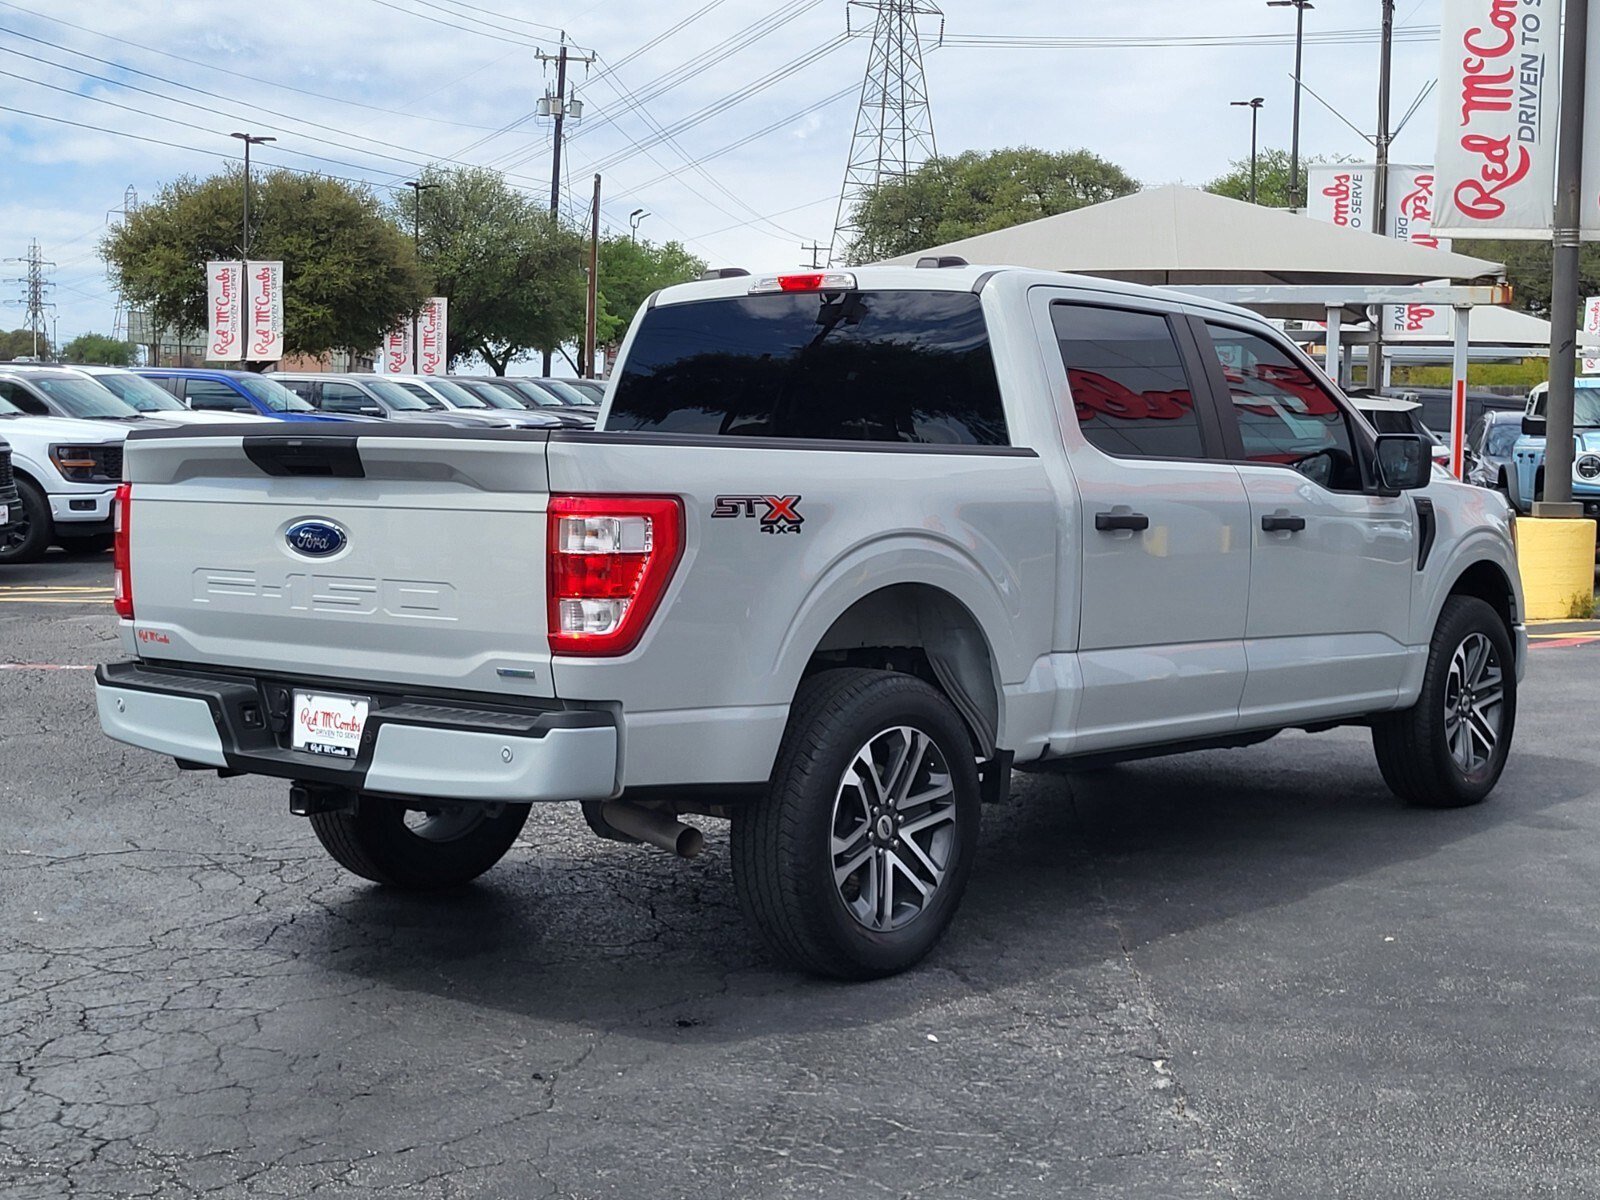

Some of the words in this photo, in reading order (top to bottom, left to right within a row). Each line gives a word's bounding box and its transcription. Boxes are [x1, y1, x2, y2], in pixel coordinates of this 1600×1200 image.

[1520, 13, 1541, 46] TO
[1459, 0, 1518, 127] McCo
[1517, 53, 1540, 143] DRIVEN
[1453, 134, 1531, 220] Red
[1322, 174, 1351, 227] ombs
[1351, 174, 1363, 214] SERVE
[1397, 217, 1408, 239] DRI
[215, 267, 230, 327] McCombs
[230, 293, 237, 302] TO
[254, 267, 271, 327] McCombs
[271, 292, 277, 301] TO
[1394, 305, 1405, 331] RVE
[1589, 301, 1600, 332] Combs
[213, 329, 235, 355] Red
[253, 329, 276, 355] Red
[389, 351, 406, 373] Red
[422, 352, 440, 374] Red
[710, 494, 805, 525] STX
[296, 526, 331, 550] Ford
[192, 566, 459, 622] F-150
[300, 707, 318, 733] Red
[321, 710, 361, 733] McCombs
[315, 728, 335, 737] DRIVEN
[310, 742, 322, 754] Red
